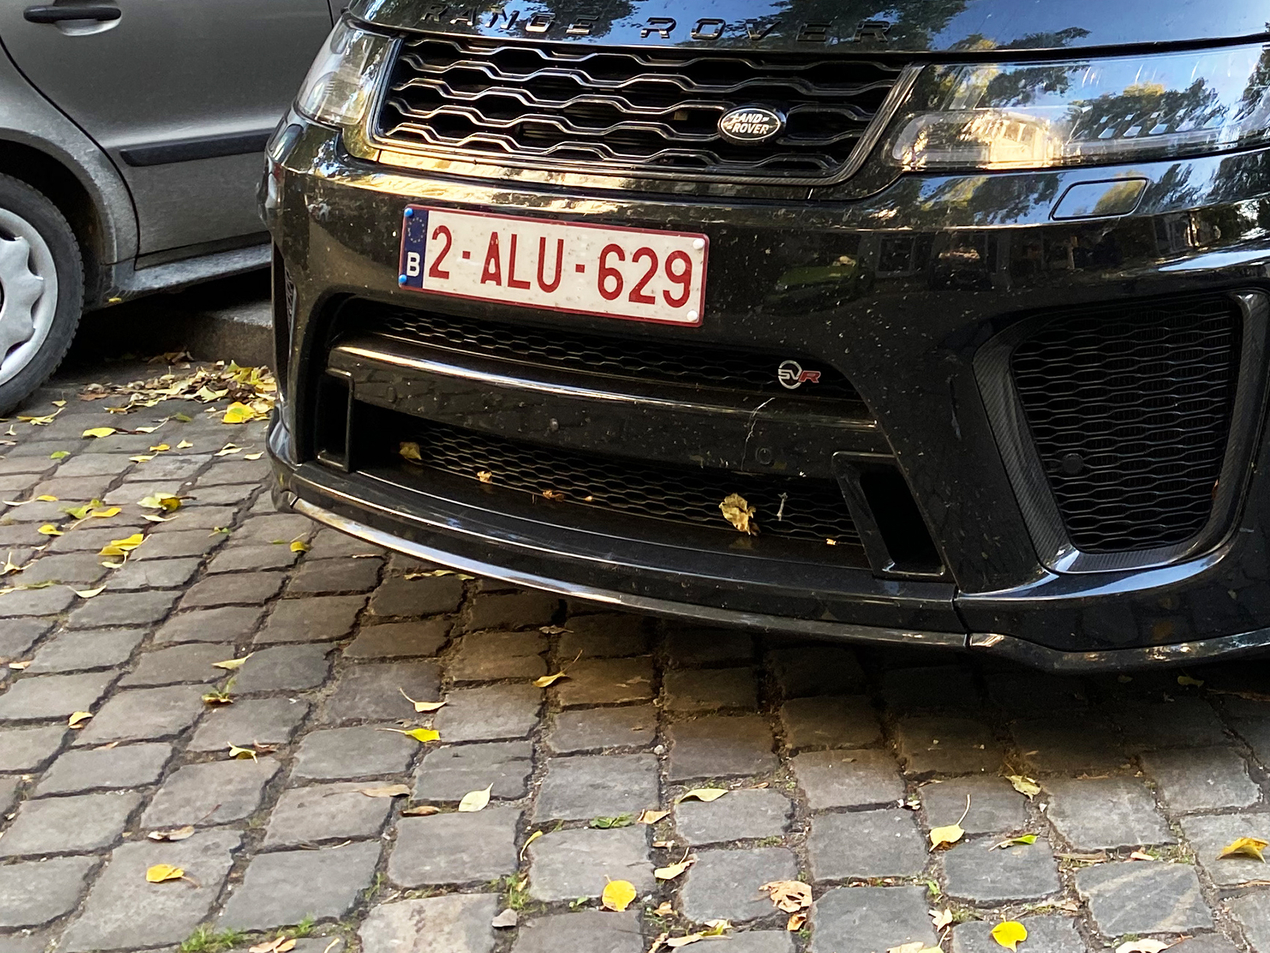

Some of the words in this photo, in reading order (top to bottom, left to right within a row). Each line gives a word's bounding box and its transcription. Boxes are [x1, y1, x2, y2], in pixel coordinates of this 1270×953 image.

[425, 4, 600, 34] RANGE
[641, 16, 894, 43] ROVER
[727, 123, 770, 136] ROVER
[732, 112, 769, 124] LAND
[406, 252, 422, 276] B
[427, 225, 694, 308] 2-ALU-629
